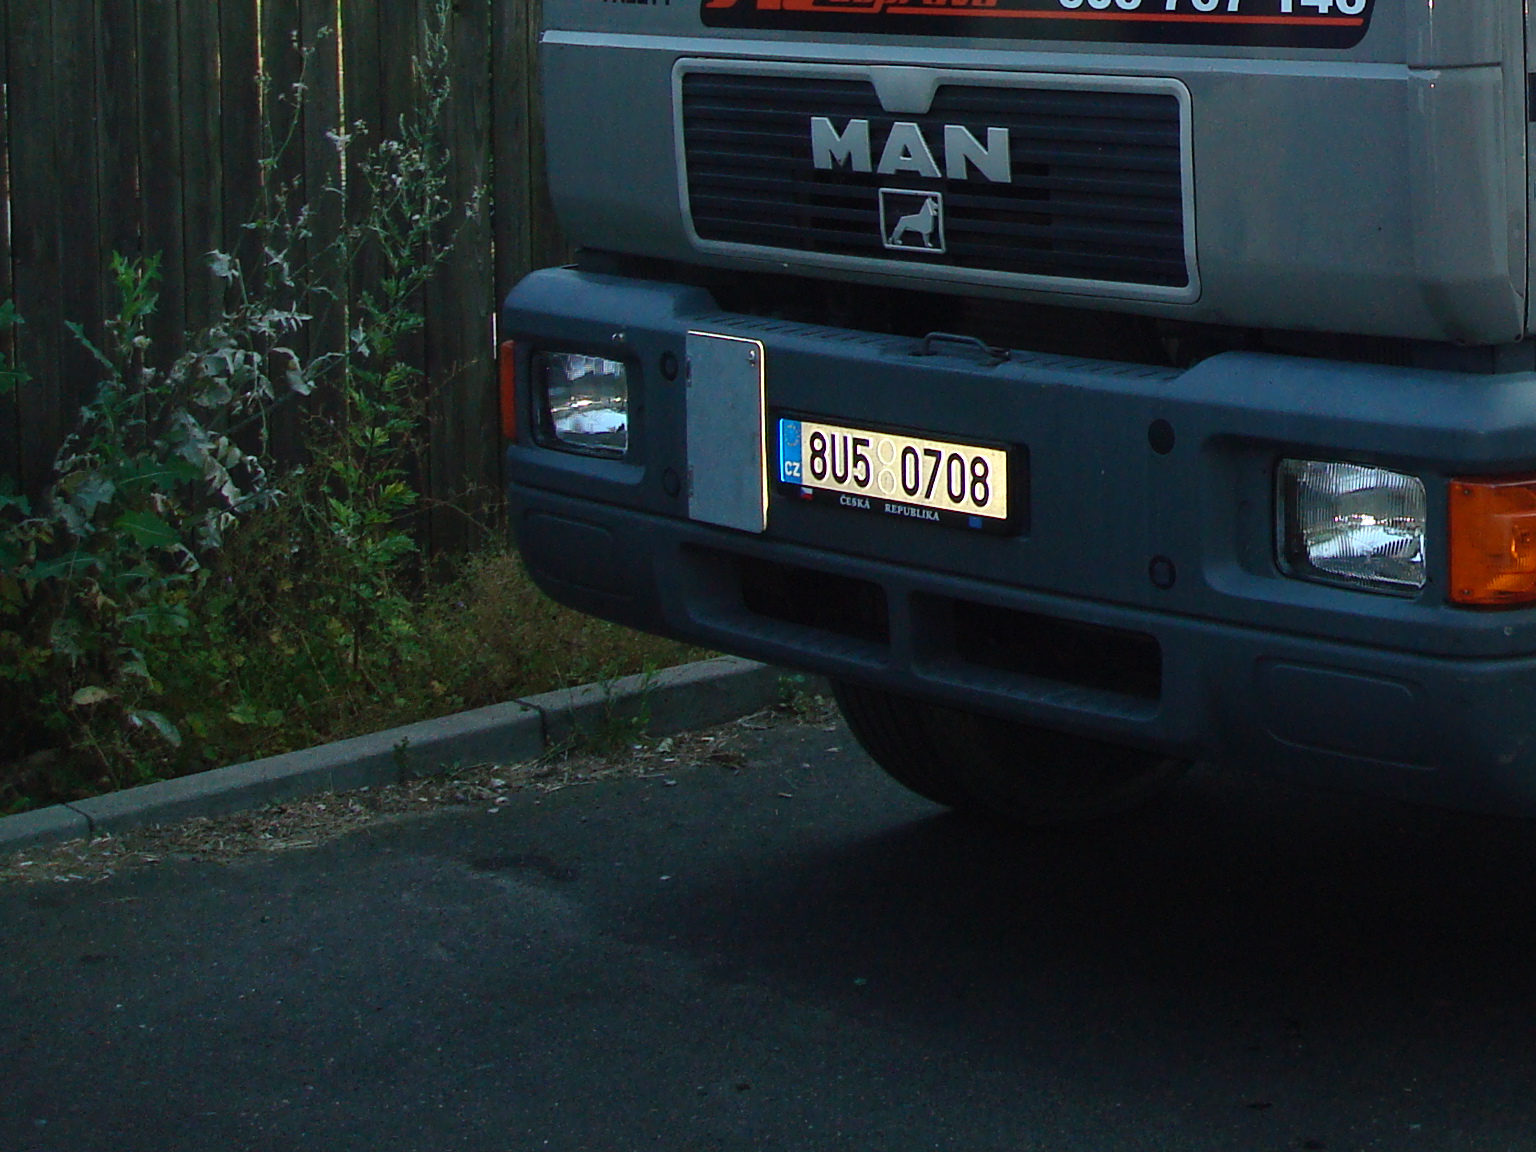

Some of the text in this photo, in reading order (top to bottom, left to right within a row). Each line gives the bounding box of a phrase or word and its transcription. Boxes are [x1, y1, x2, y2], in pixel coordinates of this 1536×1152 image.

[811, 116, 1012, 184] MAN
[784, 460, 801, 477] CZ
[809, 431, 990, 508] 8U5 0708
[839, 493, 940, 522] ČESKÁ REPUBLIKA
